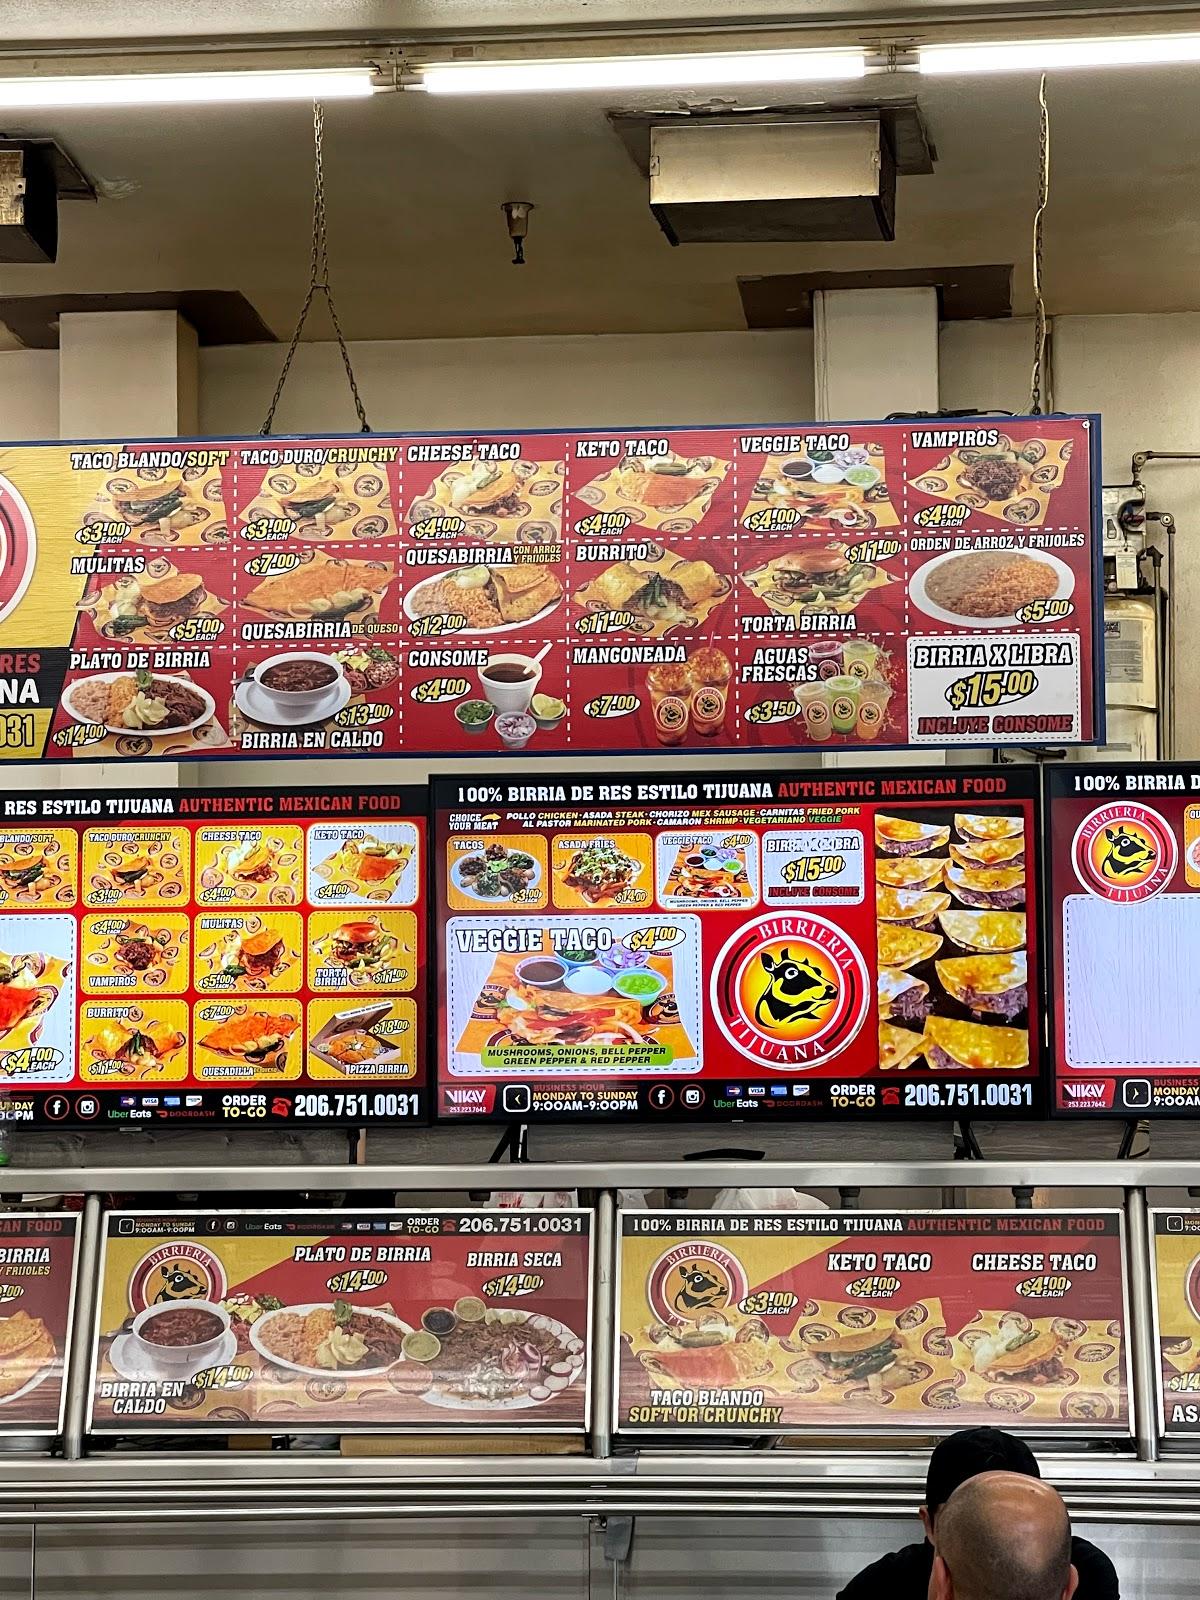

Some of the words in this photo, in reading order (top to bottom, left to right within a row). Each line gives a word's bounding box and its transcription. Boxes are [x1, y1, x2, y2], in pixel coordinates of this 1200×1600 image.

[741, 435, 801, 452] VEGGIE
[806, 434, 850, 450] TACO
[912, 430, 999, 448] VAMPIROS
[240, 450, 278, 465] TACO
[283, 447, 398, 464] DURO/CRUNCHY
[407, 445, 473, 461] CHEESE
[477, 443, 520, 460] TACO
[576, 440, 620, 457] KETO
[626, 439, 668, 455] TACO
[71, 453, 112, 469] TACO
[118, 450, 229, 468] BLANDO/SOFT
[513, 545, 530, 555] CON
[533, 544, 561, 554] ARROZ
[850, 540, 900, 562] $11.00
[910, 538, 951, 551] ORDEN
[954, 537, 971, 550] DE
[974, 536, 1014, 550] ARROZ
[1017, 536, 1026, 549] Y
[1029, 534, 1085, 548] FRIJOLES
[406, 547, 512, 565] QUESABIRRIA
[513, 554, 519, 563] Y
[521, 553, 561, 564] FRIJOLES
[576, 544, 649, 561] BURRITO
[71, 557, 145, 574] MULITAS
[241, 623, 352, 641] QUESABIRRIA
[352, 624, 365, 634] DE
[367, 623, 398, 634] QUESO
[741, 616, 794, 633] TORTA
[799, 614, 856, 632] BIRRIA
[69, 653, 122, 670] PLATO
[126, 653, 150, 669] DE
[153, 651, 210, 669] BIRRIA
[408, 649, 488, 666] CONSOME
[573, 646, 686, 664] MANGONEADA
[753, 648, 809, 665] AGUAS
[915, 646, 986, 668] BIRRIA
[988, 645, 1009, 667] X
[1009, 643, 1073, 666] LIBRA
[742, 664, 818, 682] FRESCAS
[949, 672, 1035, 709] $15.00
[918, 716, 989, 734] INCLUYE
[991, 715, 1073, 733] CONSOME
[242, 731, 296, 749] BIRRIA
[302, 731, 325, 748] EN
[330, 730, 384, 748] CALDO
[458, 786, 503, 802] 100%
[507, 786, 566, 802] BIRRIA
[571, 785, 594, 801] DE
[599, 785, 632, 801] RES
[637, 784, 698, 800] ESTILO
[703, 783, 773, 799] TIJUANA
[778, 781, 875, 797] AUTHENTIC
[881, 779, 956, 795] MEXICAN
[963, 778, 1007, 793] FOOD
[1074, 775, 1120, 791] 100%
[1125, 774, 1186, 790] BIRRIA
[5, 800, 37, 815] RES
[42, 799, 101, 814] ESTILO
[106, 798, 174, 813] TIJUANA
[179, 797, 274, 813] AUTHENTIC
[279, 796, 353, 811] MEXICAN
[358, 795, 401, 811] FOOD
[506, 812, 536, 820] POLLO
[691, 810, 712, 818] MEX
[835, 807, 861, 815] PORK
[449, 822, 473, 830] YOUR
[474, 821, 498, 830] MEAT
[450, 813, 481, 823] CHOICE
[522, 820, 535, 828] AL
[574, 819, 626, 827] MARINATED
[1081, 806, 1146, 839] BIRRIERIA
[314, 831, 338, 840] KETO
[340, 830, 364, 839] TACO
[453, 840, 484, 849] TACOS
[784, 856, 843, 883] $15.00
[1106, 867, 1168, 902] TIJUANA
[201, 919, 244, 929] MULITAS
[455, 927, 543, 952] VEGGIE
[549, 926, 612, 951] TACO
[631, 926, 677, 951] $4.00
[758, 918, 854, 970] BIRRIERIA
[89, 976, 137, 986] VAMPIROS
[87, 1007, 129, 1018] BURRITO
[728, 1014, 827, 1062] TIJUANA
[488, 1047, 553, 1056] MUSHROOMS,
[557, 1047, 598, 1056] ONIONS,
[601, 1047, 626, 1055] BELL
[628, 1046, 666, 1055] PEPPER
[503, 1056, 538, 1065] GREEN
[539, 1056, 578, 1065] PEPPER
[580, 1056, 588, 1064] &
[590, 1056, 611, 1064] RED
[612, 1055, 651, 1064] PEPPER
[532, 1092, 577, 1101] MONDAY
[580, 1092, 596, 1100] TO
[597, 1091, 638, 1100] SUNDAY
[830, 1084, 876, 1096] ORDER
[905, 1083, 1033, 1106] 206.751.0031
[222, 1095, 266, 1106] ORDER
[295, 1093, 419, 1117] 206.751.0031
[532, 1100, 639, 1111] 9:00AM-9:00PM
[830, 1096, 876, 1108] TO-GO
[222, 1107, 267, 1118] TO-GO
[407, 1218, 440, 1226] ORDER
[407, 1226, 440, 1234] TO-GO
[458, 1217, 582, 1233] 206.751.0031
[633, 1218, 672, 1232] 100%
[676, 1219, 726, 1232] BIRRIA
[730, 1219, 749, 1231] DE
[753, 1219, 782, 1231] RES
[786, 1219, 839, 1231] ESTILO
[843, 1218, 903, 1231] TIJUANA
[907, 1218, 991, 1231] AUTHENTIC
[996, 1218, 1062, 1231] MEXICAN
[1067, 1218, 1105, 1231] FOOD
[149, 1245, 212, 1268] BIRRIERIA
[294, 1247, 345, 1262] PLATO
[350, 1247, 372, 1261] DE
[377, 1246, 431, 1261] BIRRIA
[466, 1252, 519, 1267] BIRRIA
[523, 1252, 562, 1266] SECA
[665, 1245, 732, 1269] BIRRIERIA
[972, 1254, 1043, 1271] CHEESE
[1049, 1254, 1098, 1271] TACO
[827, 1255, 877, 1272] KETO
[883, 1254, 932, 1271] TACO
[330, 1270, 386, 1292] $14.00
[486, 1274, 542, 1297] $14.00
[745, 1292, 794, 1314] $3.00
[101, 1383, 157, 1398] BIRRIA
[162, 1382, 185, 1397] EN
[650, 1390, 693, 1406] TACO
[698, 1390, 764, 1406] BLANDO
[113, 1398, 166, 1414] CALDO
[629, 1407, 673, 1423] SOFT
[676, 1407, 698, 1423] OR
[703, 1407, 783, 1423] CRUNCHY
